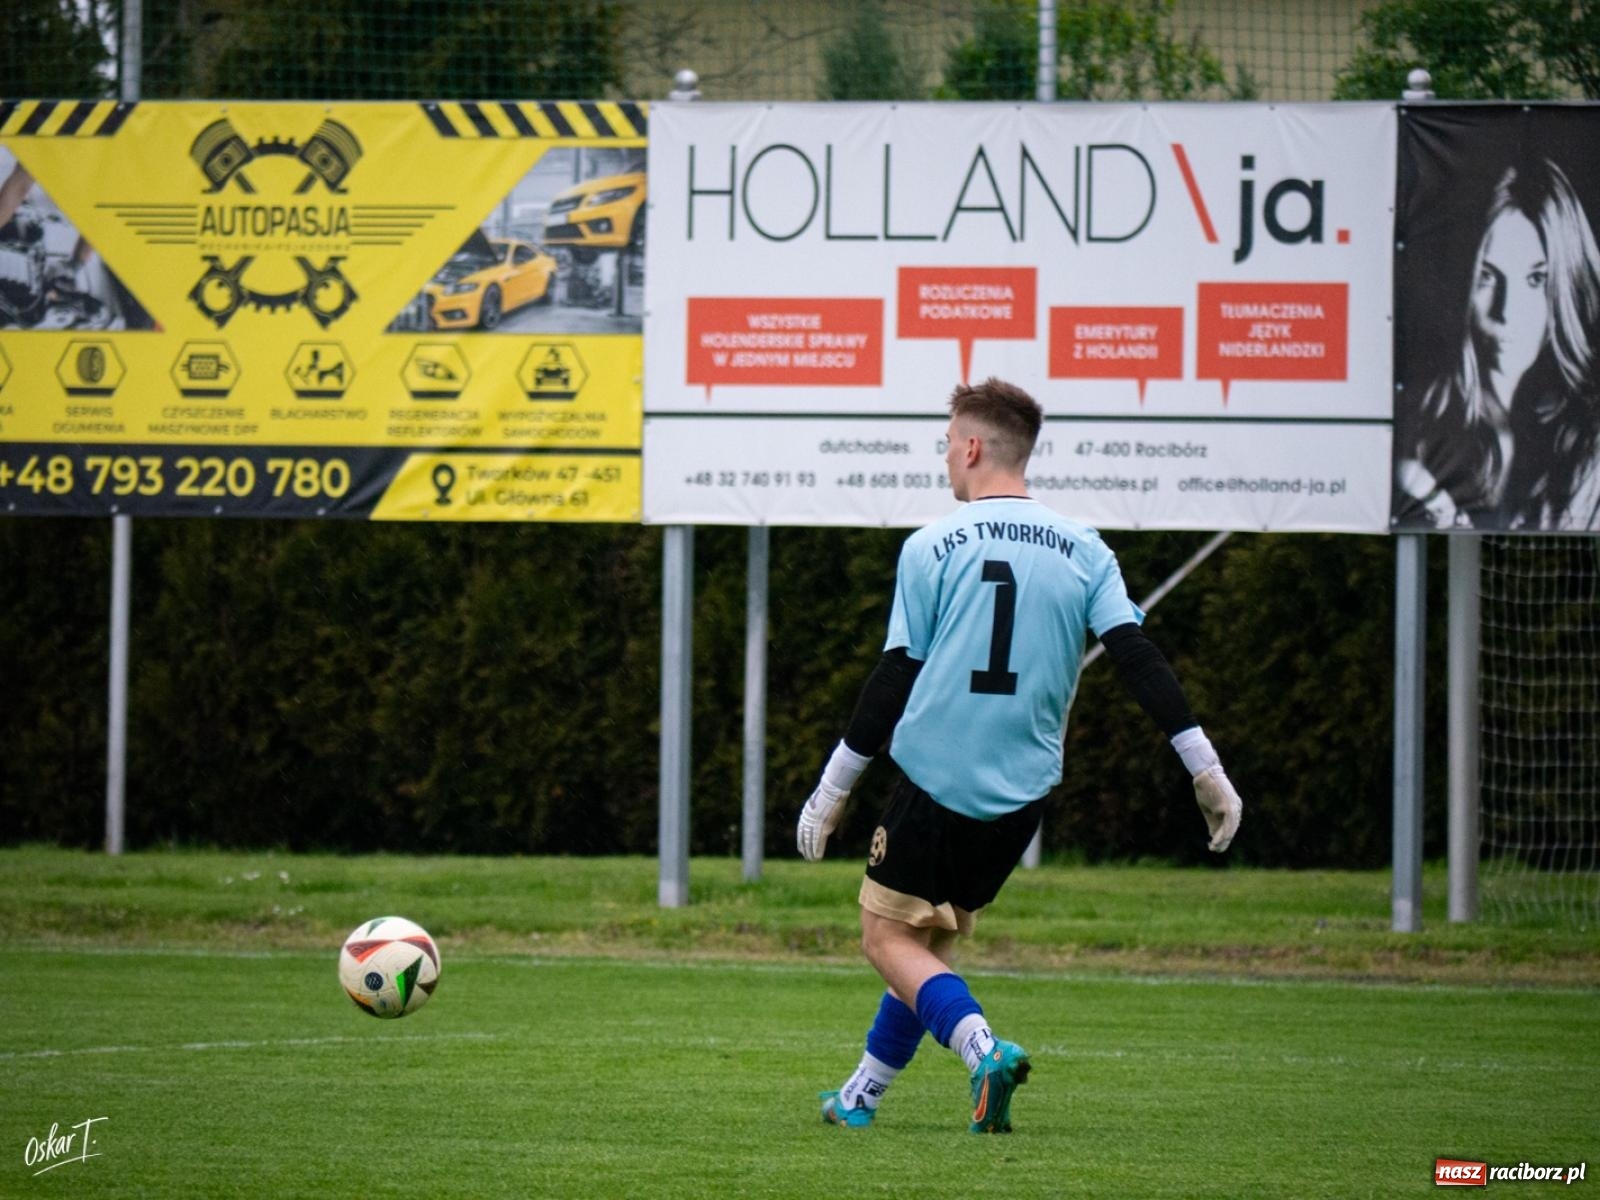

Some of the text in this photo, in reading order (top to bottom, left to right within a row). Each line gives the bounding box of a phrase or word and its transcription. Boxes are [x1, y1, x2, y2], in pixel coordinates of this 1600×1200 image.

[688, 142, 1157, 246] HOLLAND
[201, 206, 351, 236] AUTOPASJA
[920, 304, 1012, 319] PODATKOWE
[1220, 304, 1324, 319] TŁUMACZENIA
[1074, 324, 1158, 340] EMERYTURY
[1248, 323, 1290, 340] JĘZYK
[809, 334, 867, 349] SPRAWY
[1073, 343, 1083, 359] Z
[1219, 342, 1325, 358] NIDERLANDZKI
[713, 352, 856, 368] W JEDNYM MIEJSCU
[65, 407, 114, 418] SERWIS
[1075, 442, 1130, 456] 47-400
[1136, 441, 1207, 458] Racibórz
[0, 456, 350, 498] +48 793 220 780
[467, 465, 551, 481] Tworków
[685, 472, 816, 487] +48 32 740 91 93
[837, 473, 864, 487] +48
[870, 474, 898, 488] 608
[904, 474, 931, 488] 003
[1178, 476, 1347, 495] office@holland-ja.pl
[933, 521, 1075, 562] LKS TWORKÓW
[969, 560, 1018, 696] 1
